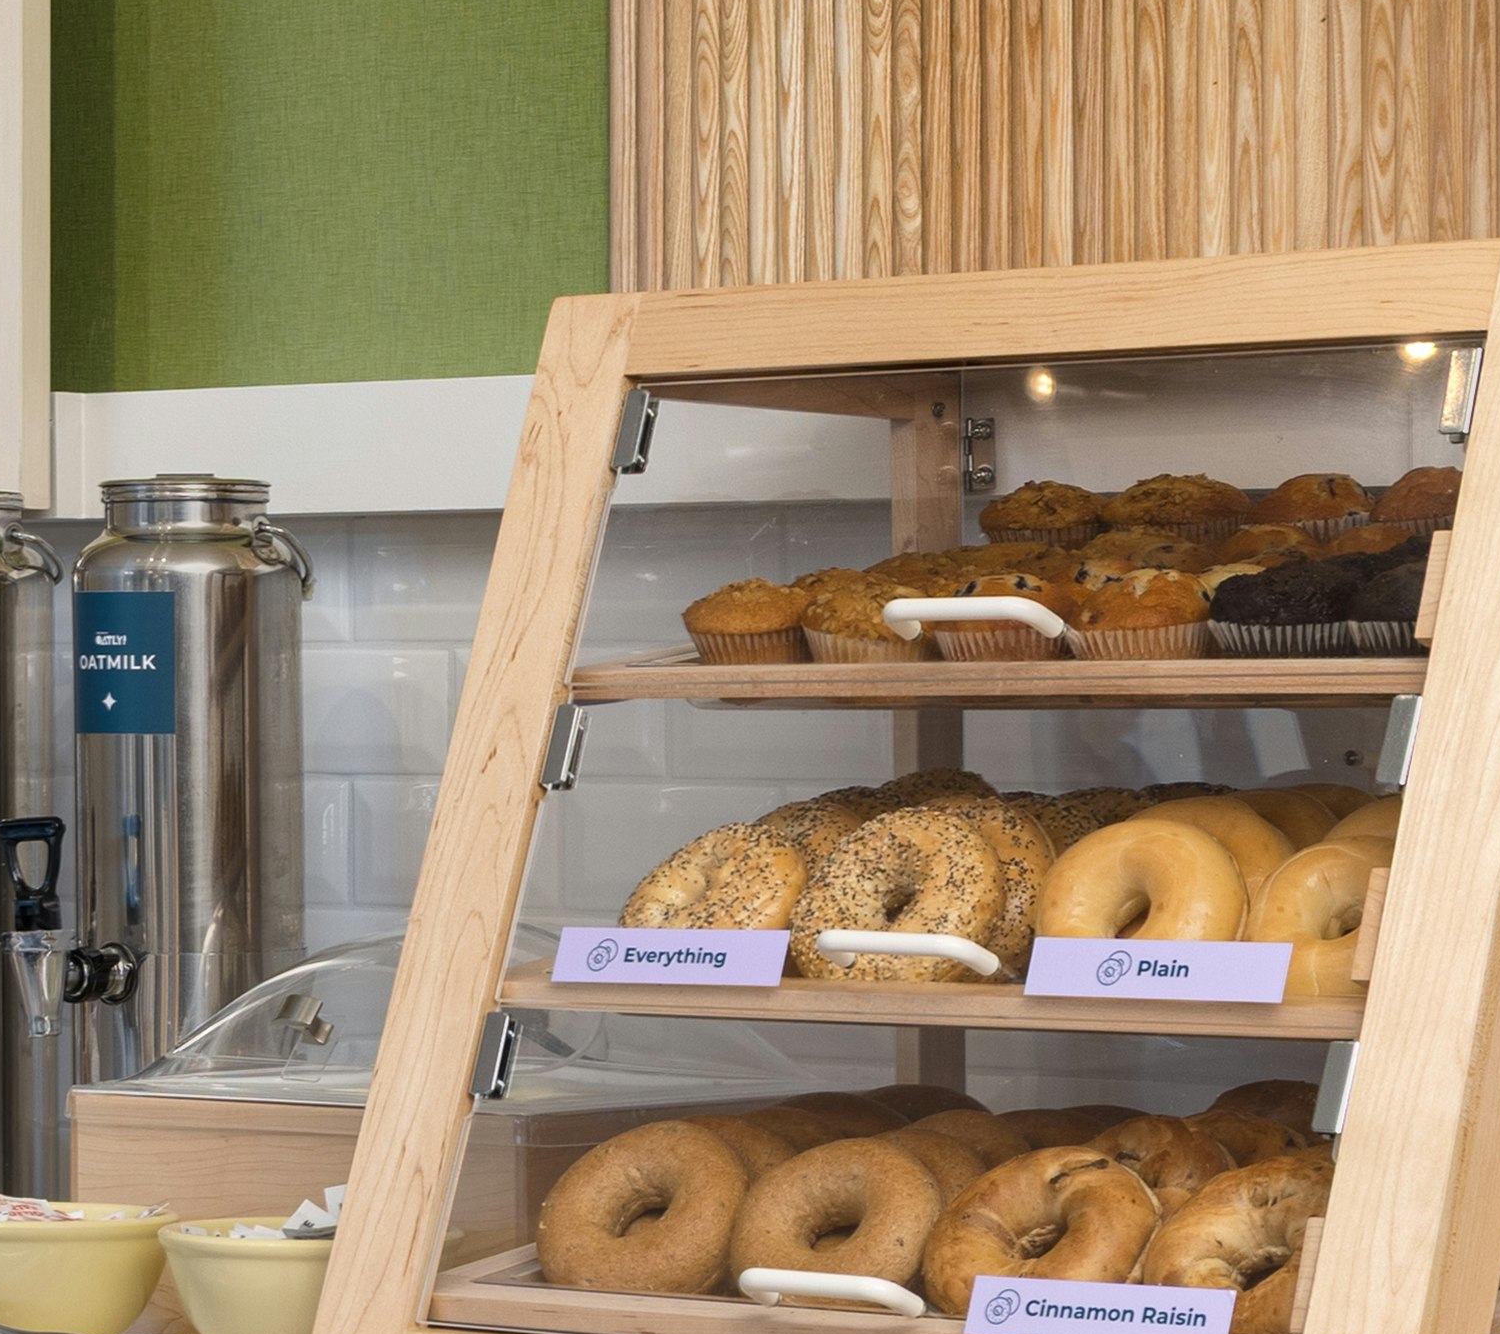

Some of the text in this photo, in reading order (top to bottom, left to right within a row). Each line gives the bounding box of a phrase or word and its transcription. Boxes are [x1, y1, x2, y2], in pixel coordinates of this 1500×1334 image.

[95, 634, 127, 646] OATLY!
[79, 654, 157, 670] OATMILK
[623, 947, 728, 968] Everything
[1136, 959, 1190, 978] Plain
[1025, 1298, 1207, 1327] Cinnamon Raisin
